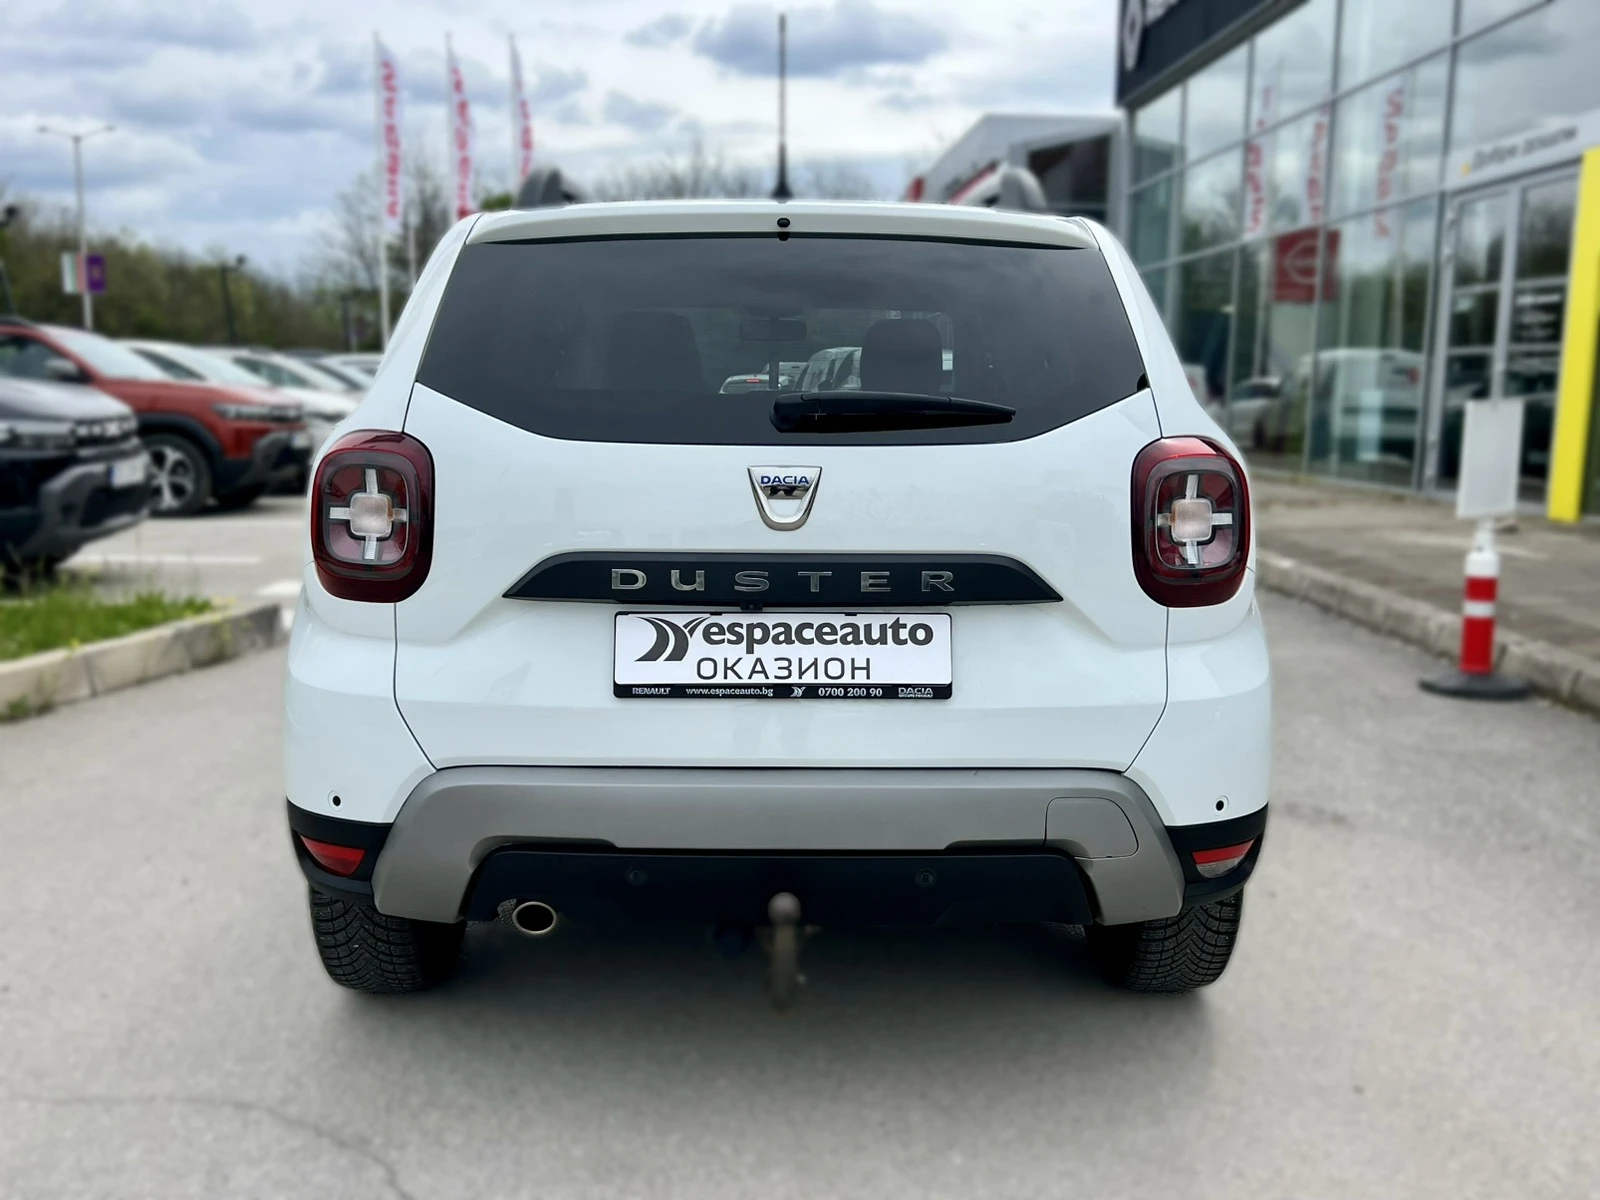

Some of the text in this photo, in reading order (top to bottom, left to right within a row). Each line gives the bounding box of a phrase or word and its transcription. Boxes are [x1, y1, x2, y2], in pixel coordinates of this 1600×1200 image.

[760, 475, 810, 485] DACIA
[611, 568, 955, 592] DUSTER
[702, 616, 934, 655] espaceauto
[696, 657, 871, 681] ОКАЗИОН
[632, 687, 671, 695] RENAULT
[685, 687, 774, 697] www.espaceauto.bg
[818, 687, 883, 697] 0700 200 90
[898, 687, 934, 695] DACIA
